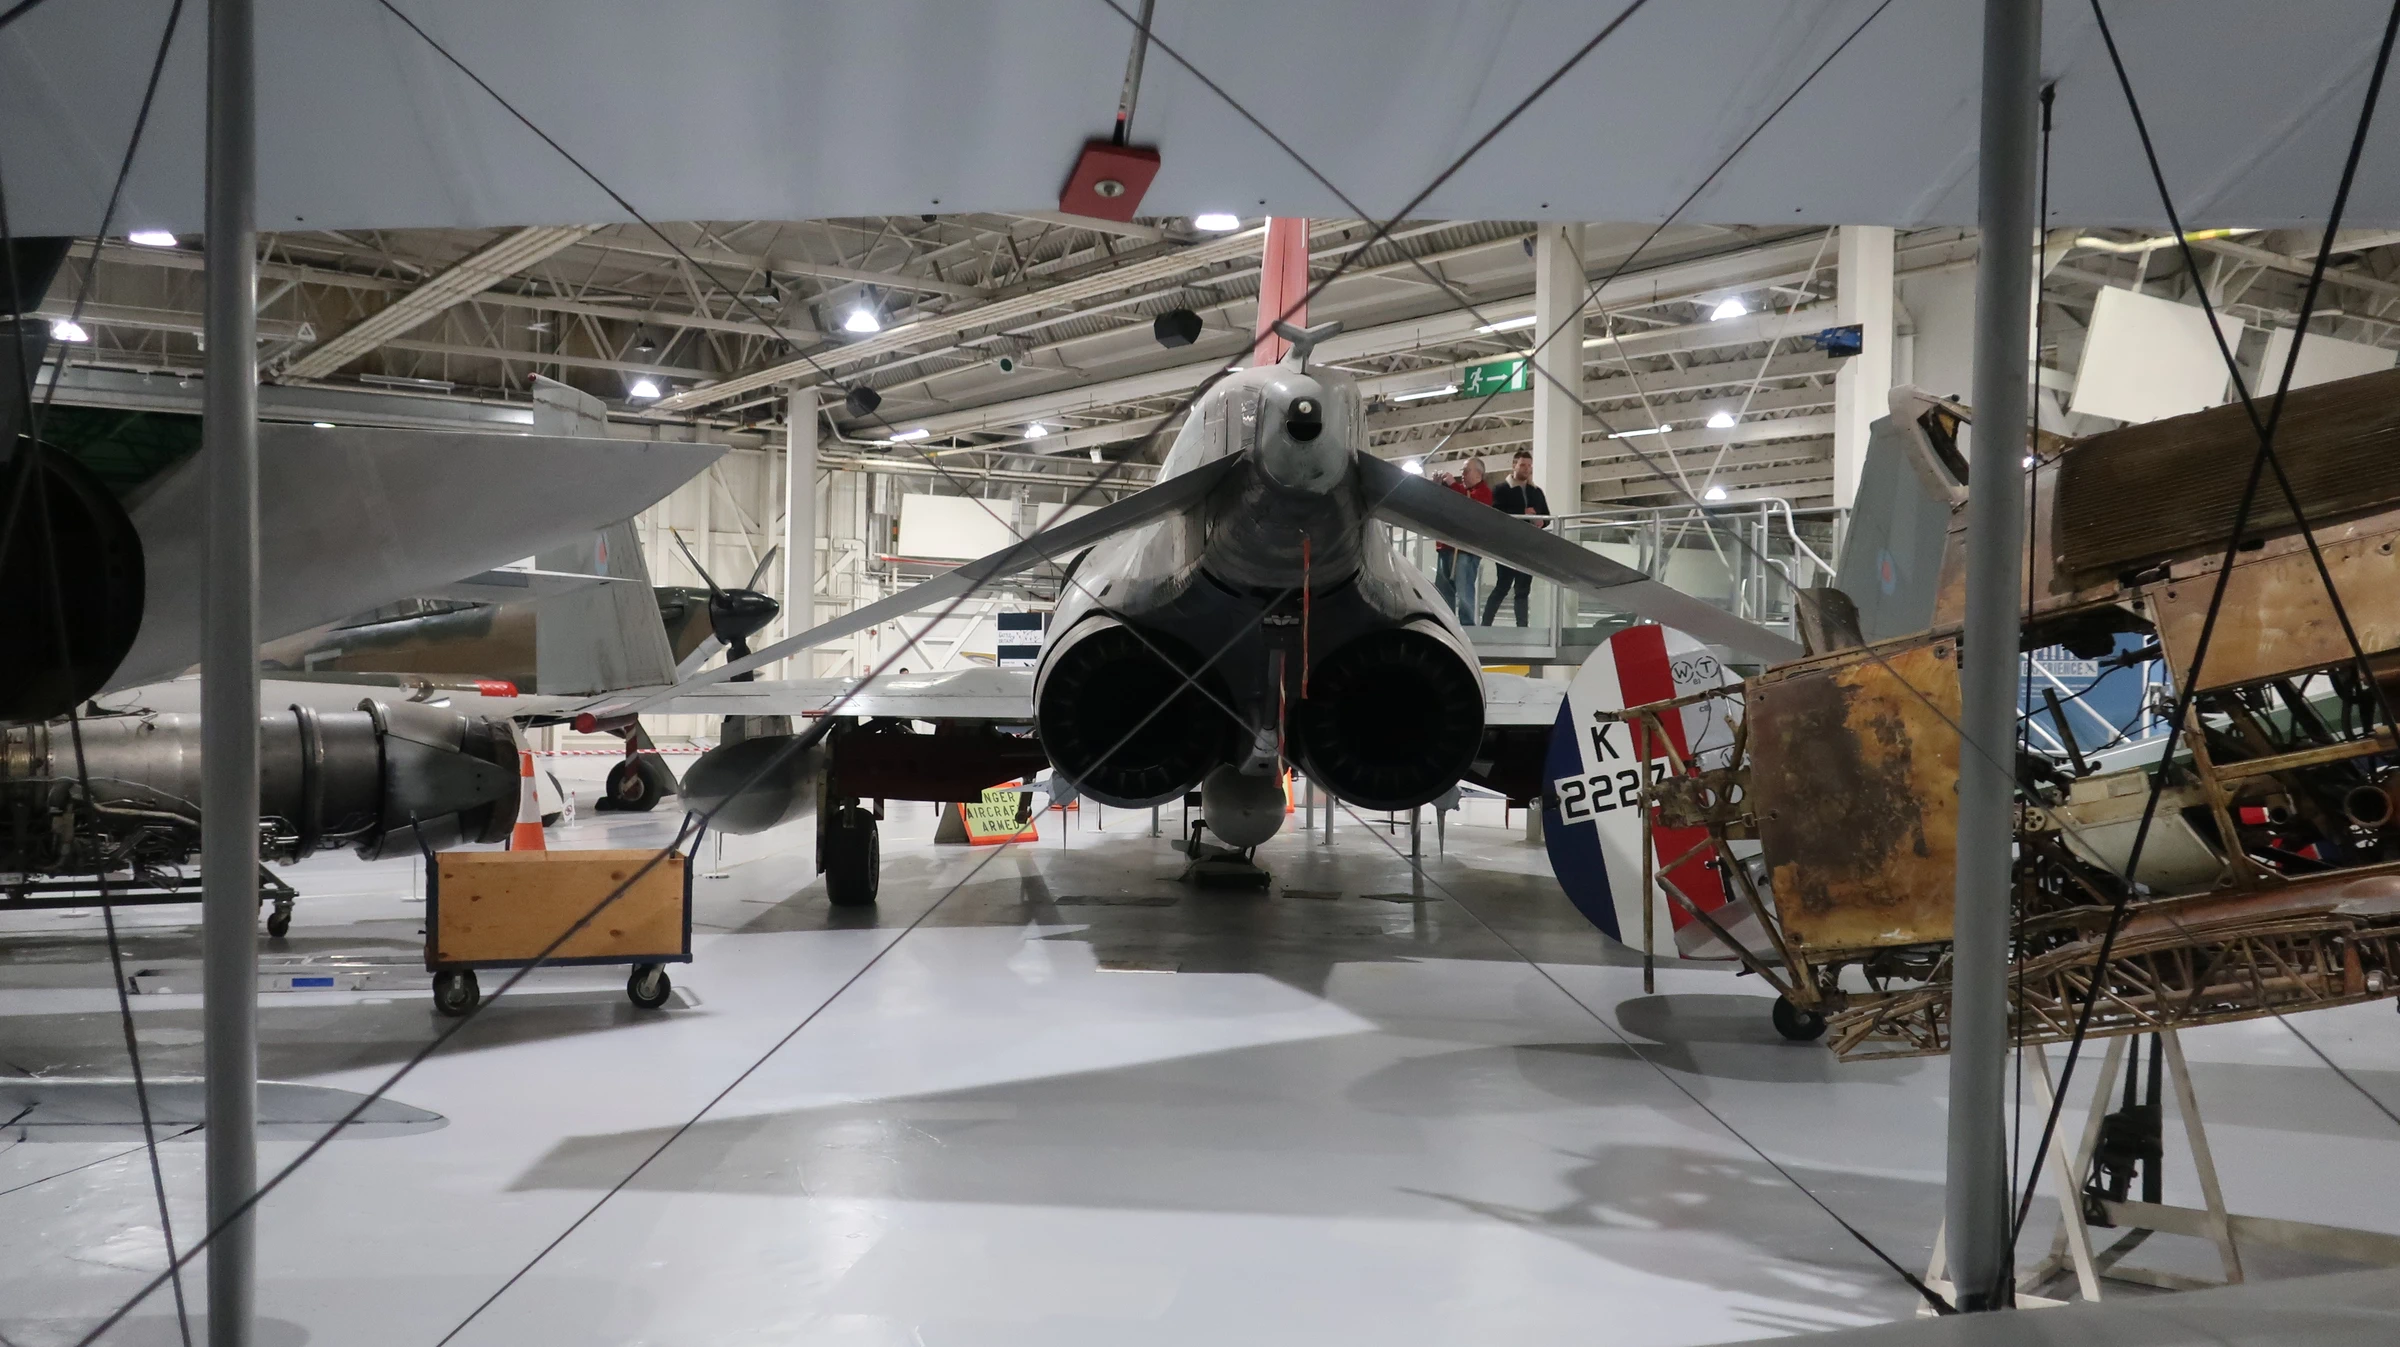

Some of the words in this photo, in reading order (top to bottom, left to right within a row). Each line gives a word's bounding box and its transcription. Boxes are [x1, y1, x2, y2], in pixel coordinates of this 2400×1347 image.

[1674, 666, 1688, 679] W
[1700, 661, 1711, 673] T
[1591, 723, 1620, 762] K
[984, 791, 1016, 804] NGER
[967, 804, 1019, 820] AIRCRAF
[982, 820, 1020, 833] ARMED
